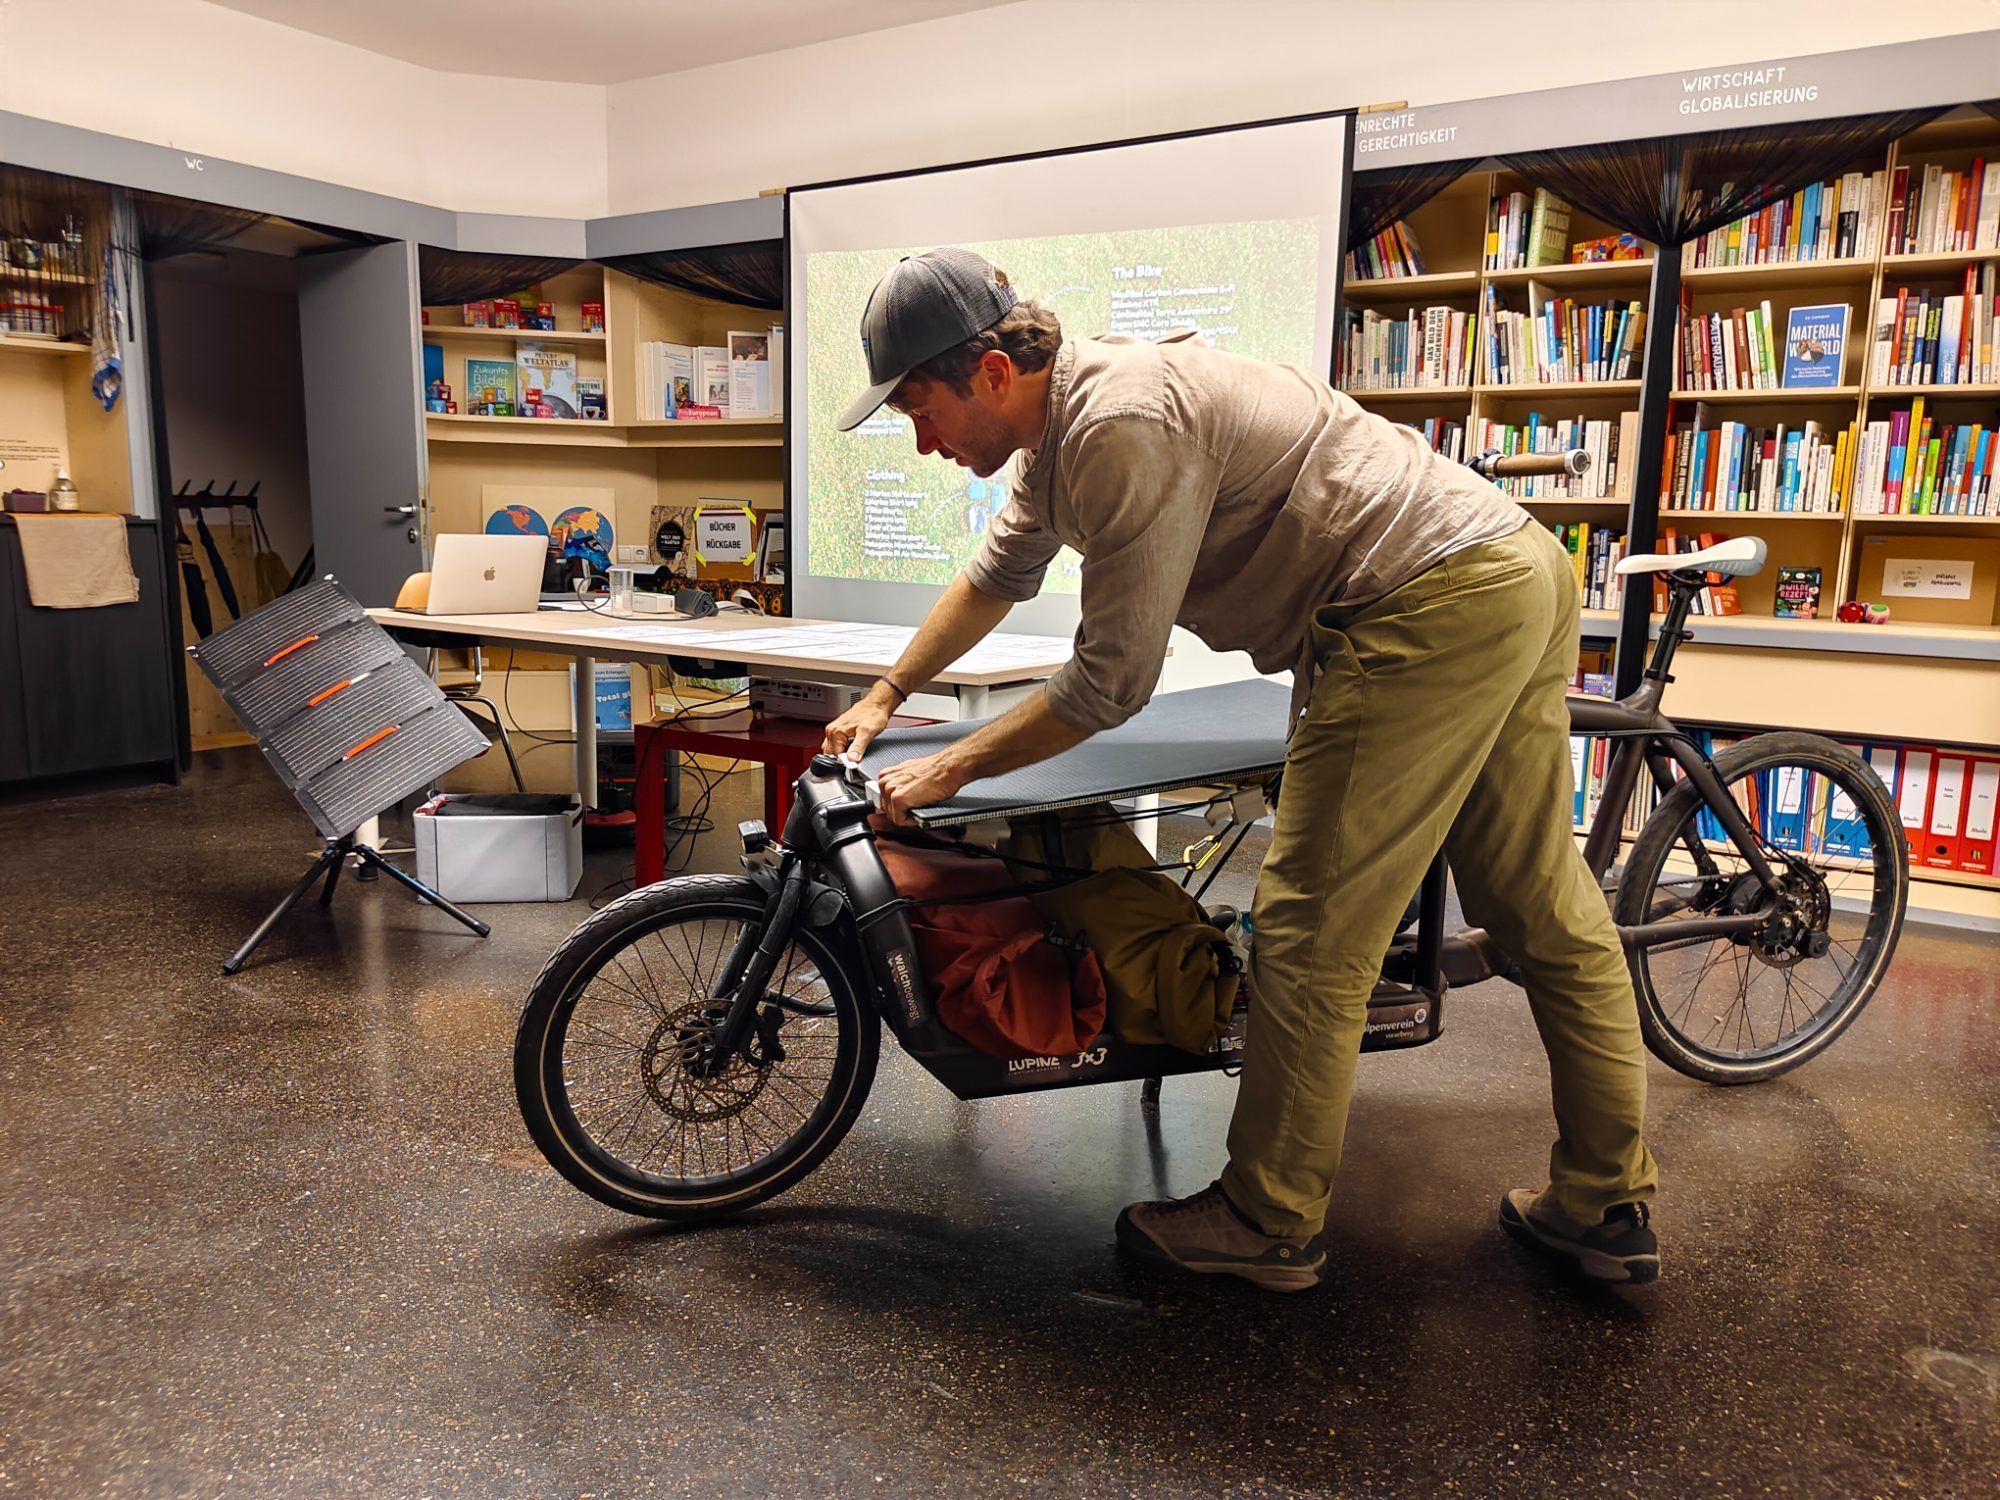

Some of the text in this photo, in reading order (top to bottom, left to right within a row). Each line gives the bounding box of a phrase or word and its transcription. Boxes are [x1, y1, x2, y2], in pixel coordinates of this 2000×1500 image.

[1682, 67, 1786, 93] WIRTSCHAFT
[1679, 86, 1818, 115] GLOBALISIERUNG
[1359, 127, 1457, 153] GERECHTIGKEIT
[184, 157, 204, 171] WC
[1112, 264, 1162, 280] The Bike
[1790, 323, 1841, 342] MATERIAL
[1433, 308, 1444, 379] MENSCHENRECHTE
[1789, 340, 1841, 358] WRLD
[524, 357, 569, 367] WELTATLAS
[473, 365, 509, 376] Zukunfts
[473, 374, 508, 387] Bilder
[866, 469, 906, 482] Clothing
[709, 520, 736, 531] BÜCHER
[706, 539, 741, 549] RÜCKGABE
[1780, 590, 1812, 599] REZEPTE
[596, 691, 620, 703] Total
[894, 953, 920, 1020] walchbewegt
[1367, 1018, 1415, 1035] lpenverein
[1009, 1057, 1060, 1072] LUPINE
